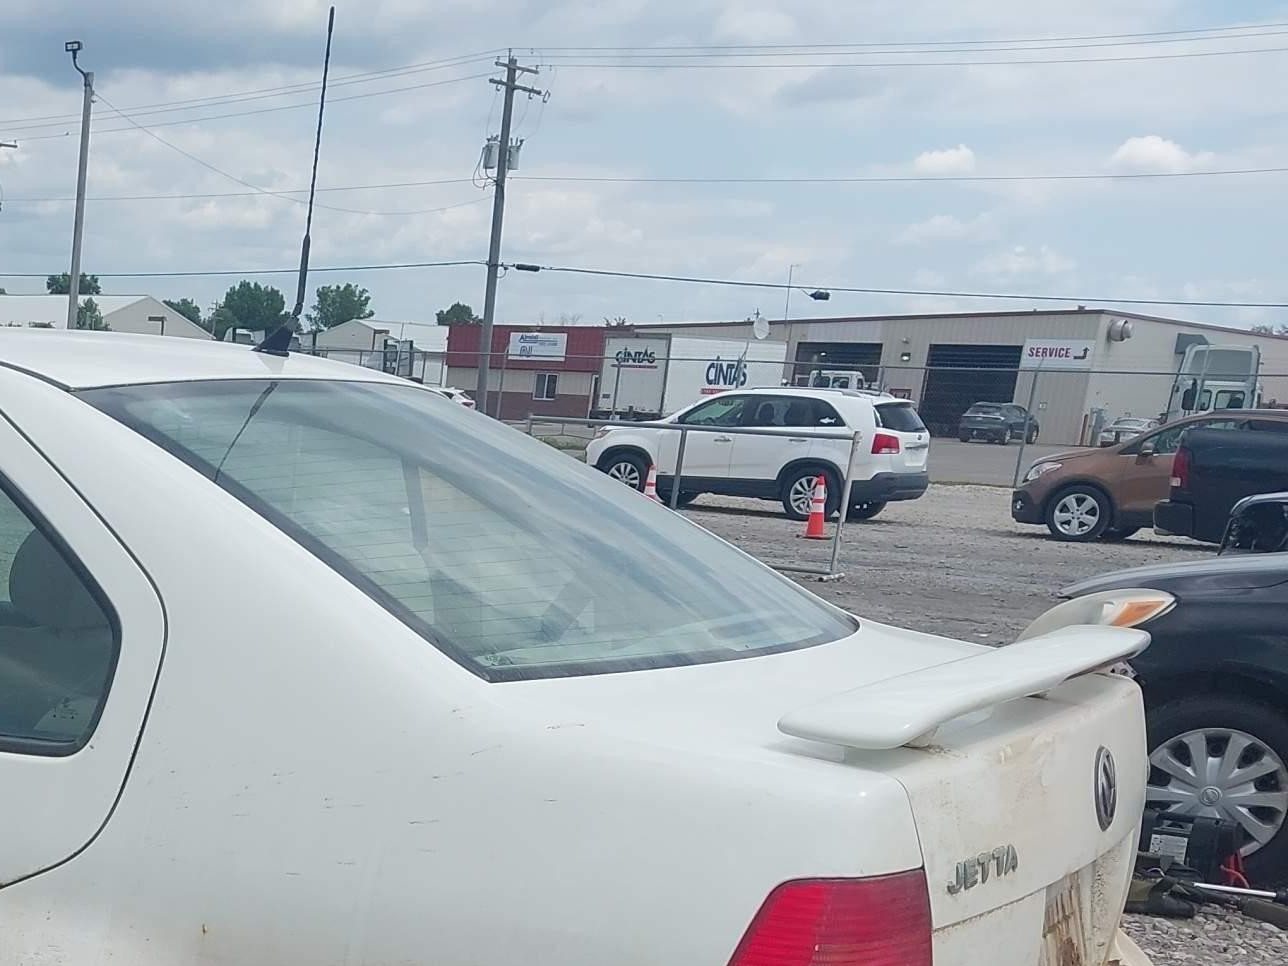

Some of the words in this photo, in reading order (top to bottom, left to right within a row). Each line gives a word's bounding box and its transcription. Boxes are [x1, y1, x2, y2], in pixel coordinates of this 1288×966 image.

[615, 345, 656, 364] CINTAS
[1027, 346, 1072, 358] SERVICE
[705, 355, 748, 387] CINTAS
[947, 844, 1018, 895] JETTA
